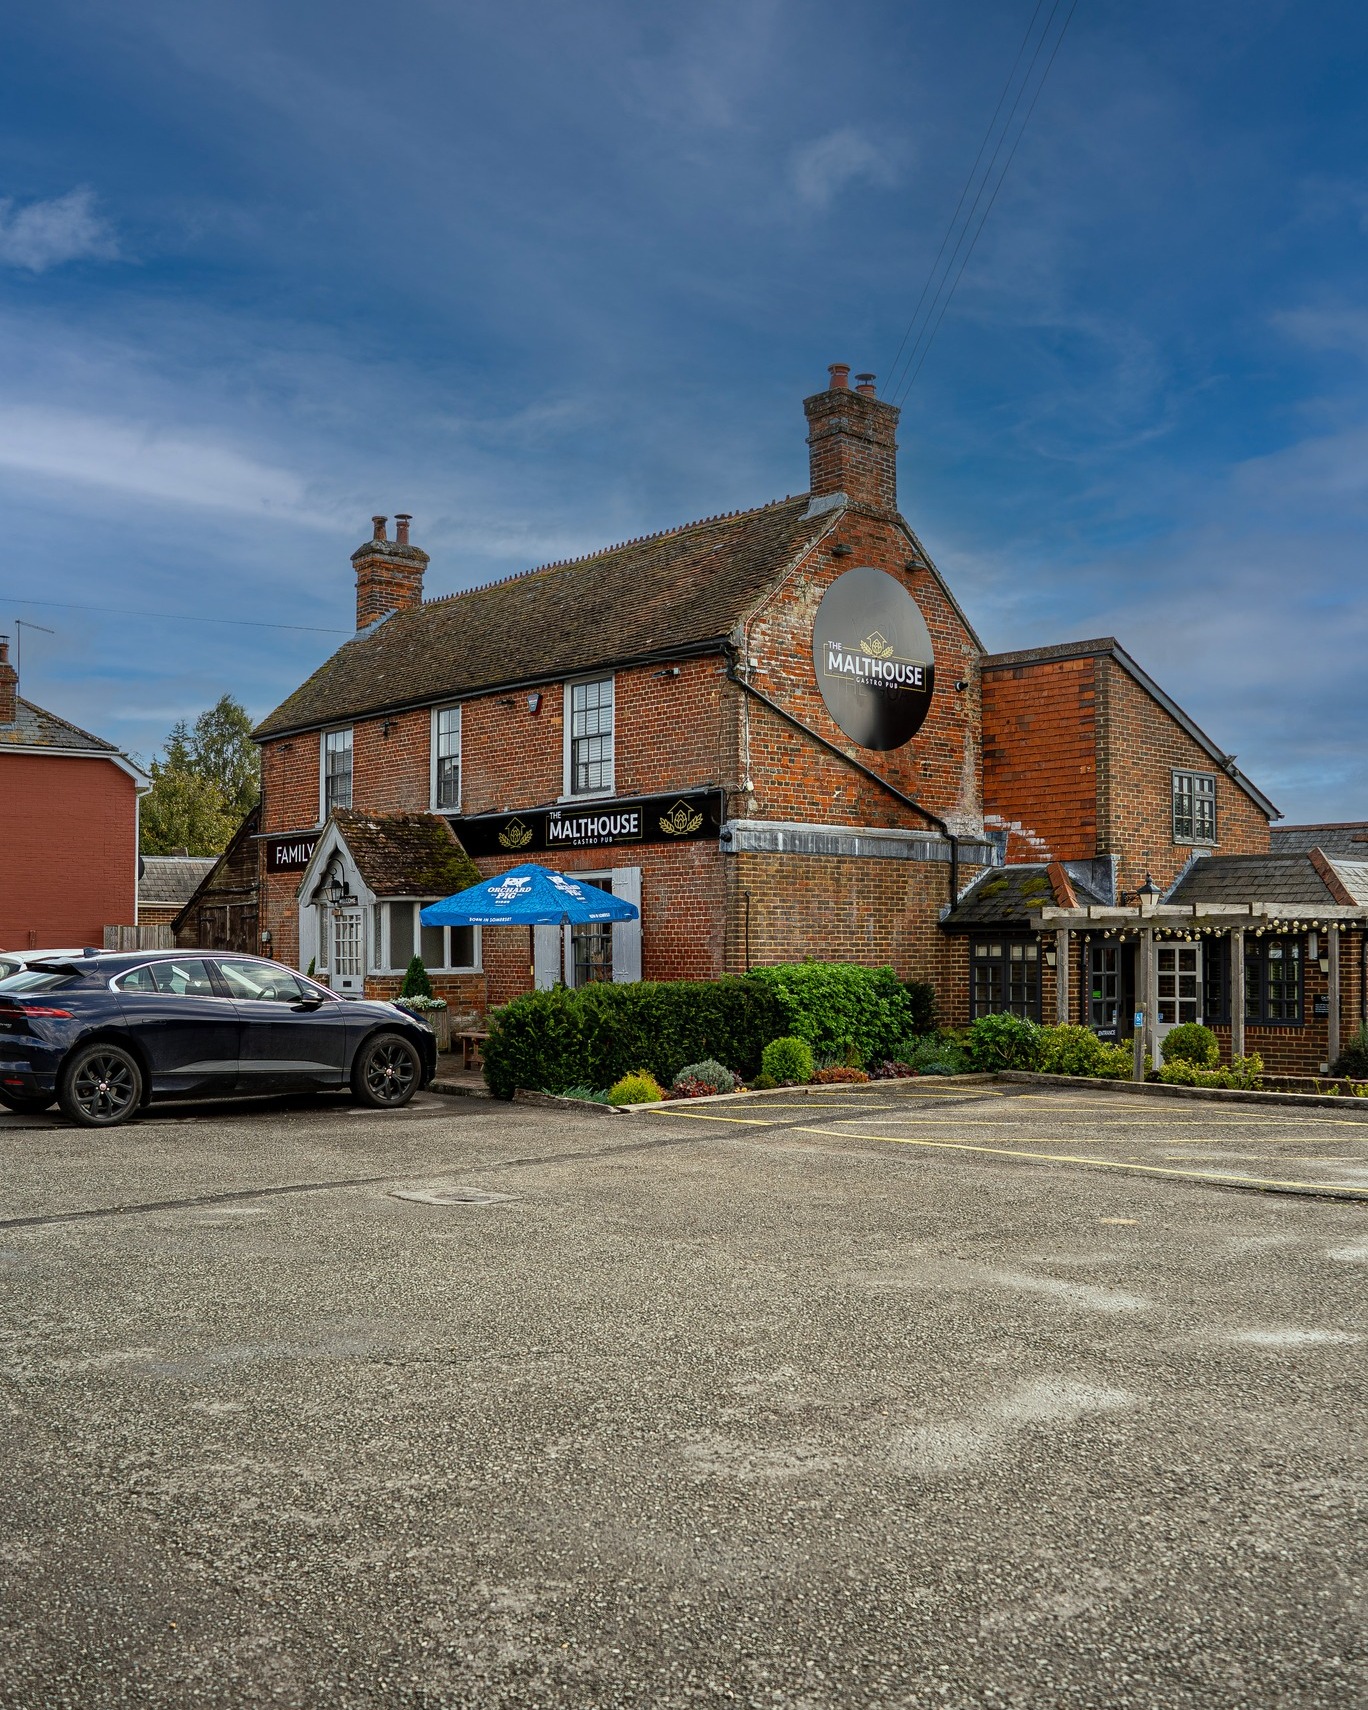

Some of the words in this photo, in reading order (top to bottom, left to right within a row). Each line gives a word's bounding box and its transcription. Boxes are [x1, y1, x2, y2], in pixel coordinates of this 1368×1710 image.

[828, 640, 842, 650] THE
[828, 651, 923, 686] MALTHOUSE
[855, 677, 883, 687] GASTRO
[885, 681, 898, 689] PUB
[549, 811, 562, 820] THE
[549, 813, 639, 840] MALTHOUSE
[572, 838, 598, 846] GASTRO
[276, 843, 315, 865] FAMILY
